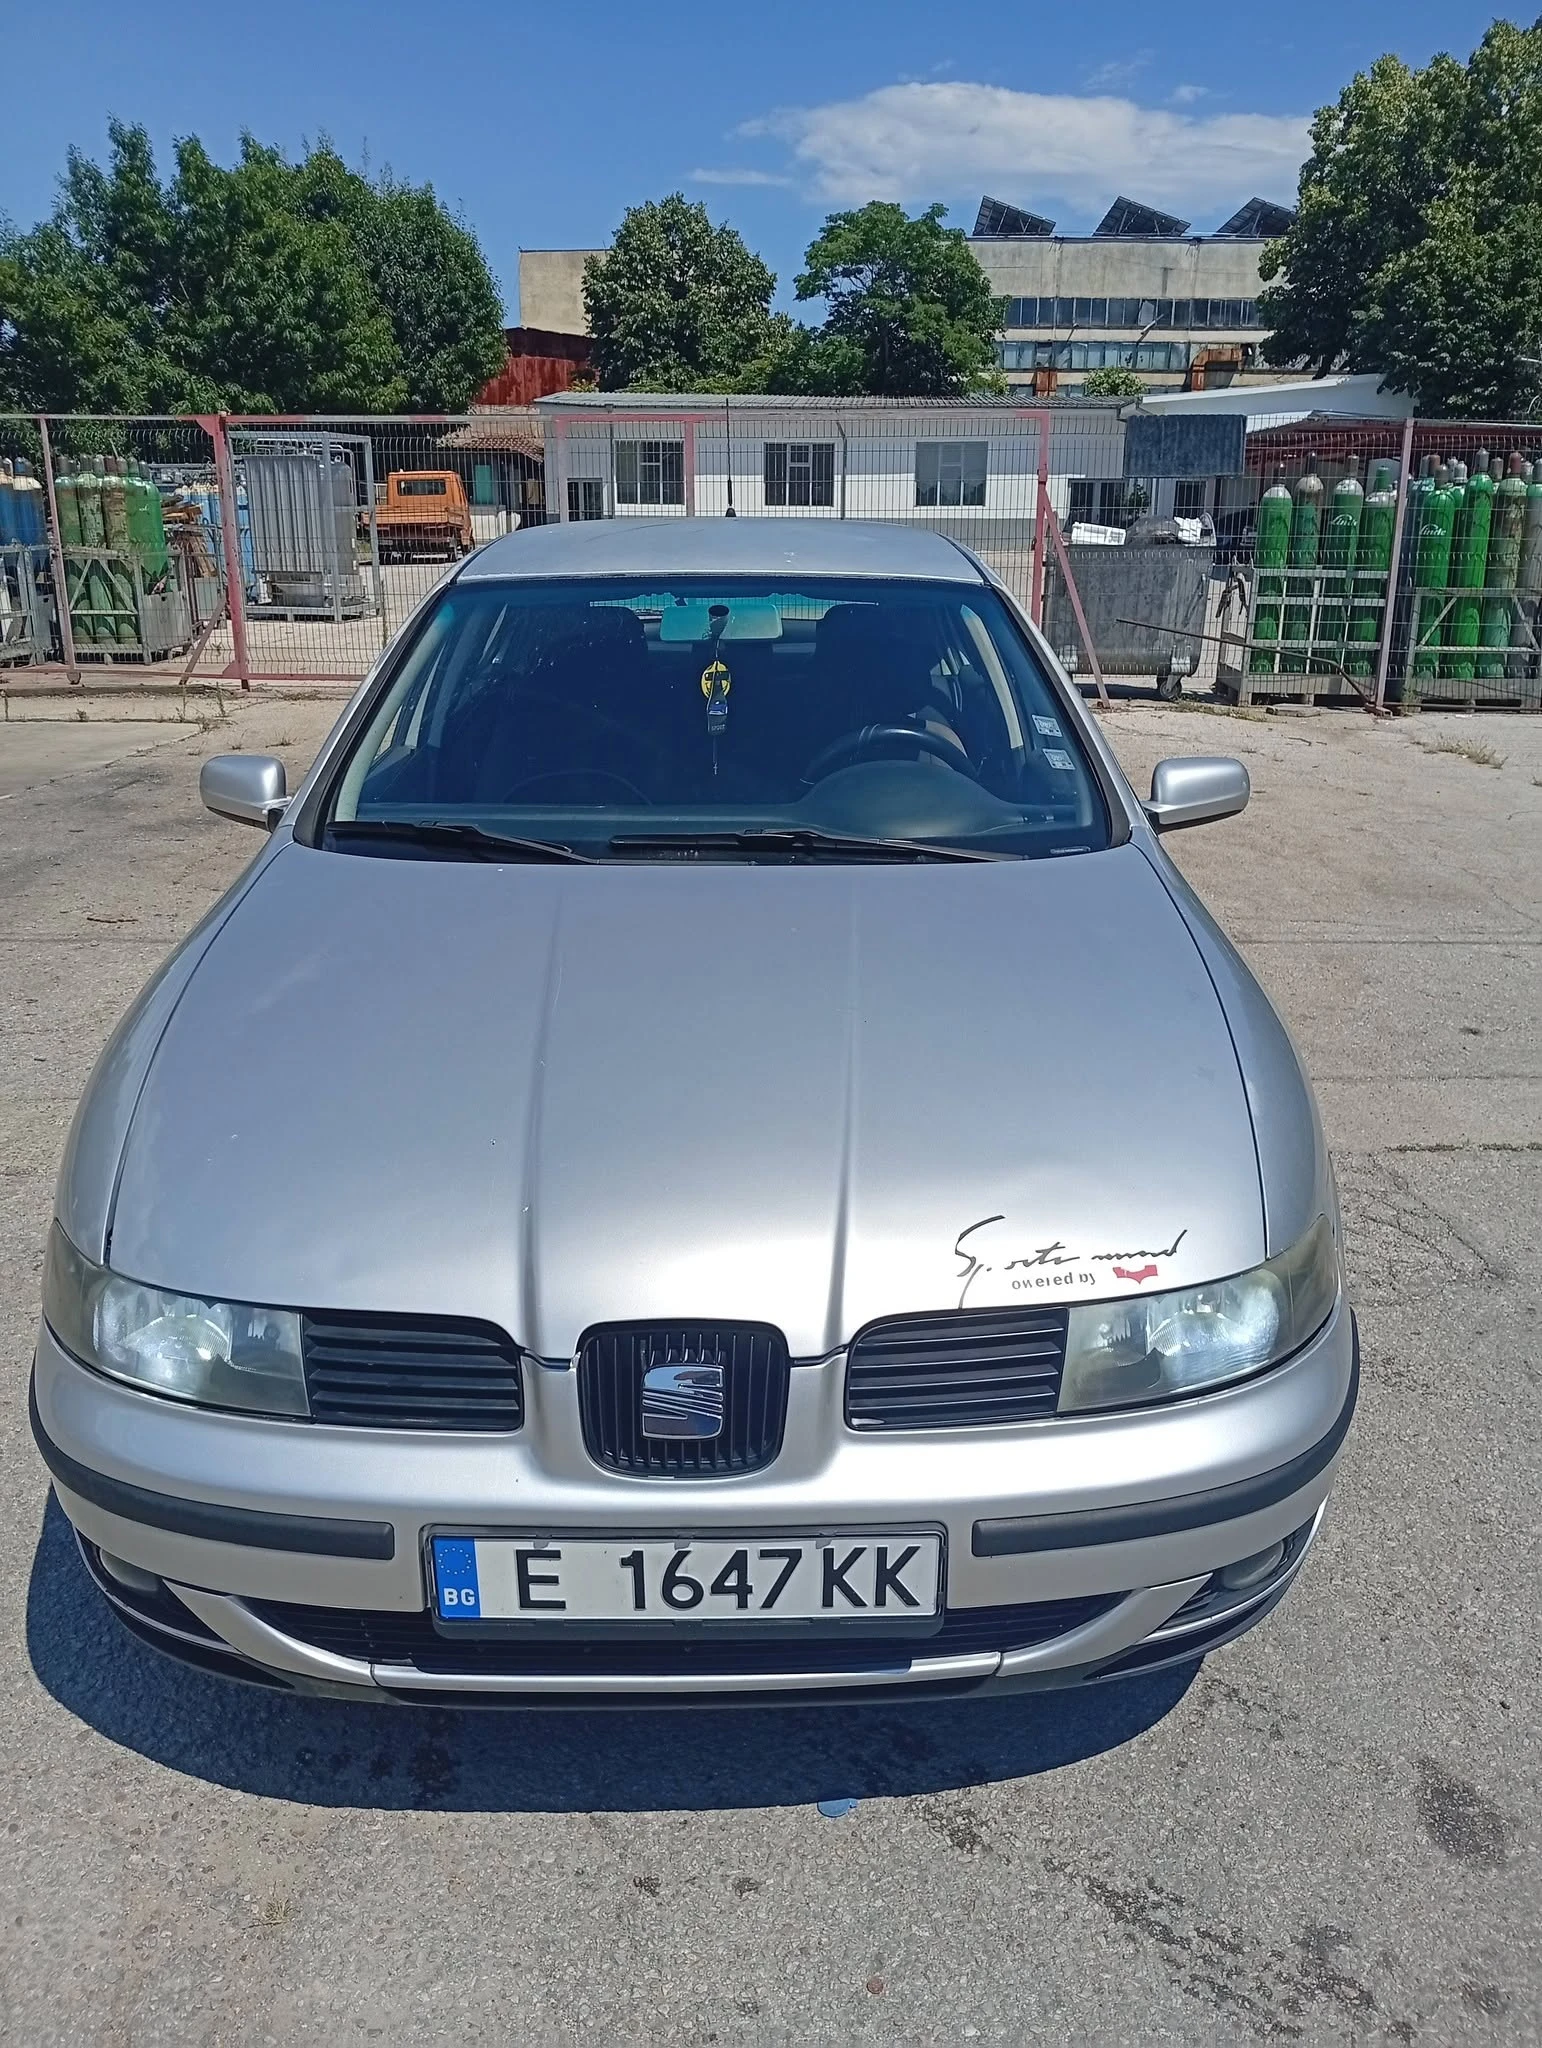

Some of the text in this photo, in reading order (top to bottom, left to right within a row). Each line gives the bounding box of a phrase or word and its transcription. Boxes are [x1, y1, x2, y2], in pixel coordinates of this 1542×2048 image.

[443, 1587, 476, 1606] BG
[515, 1545, 922, 1611] E 1647 KK
